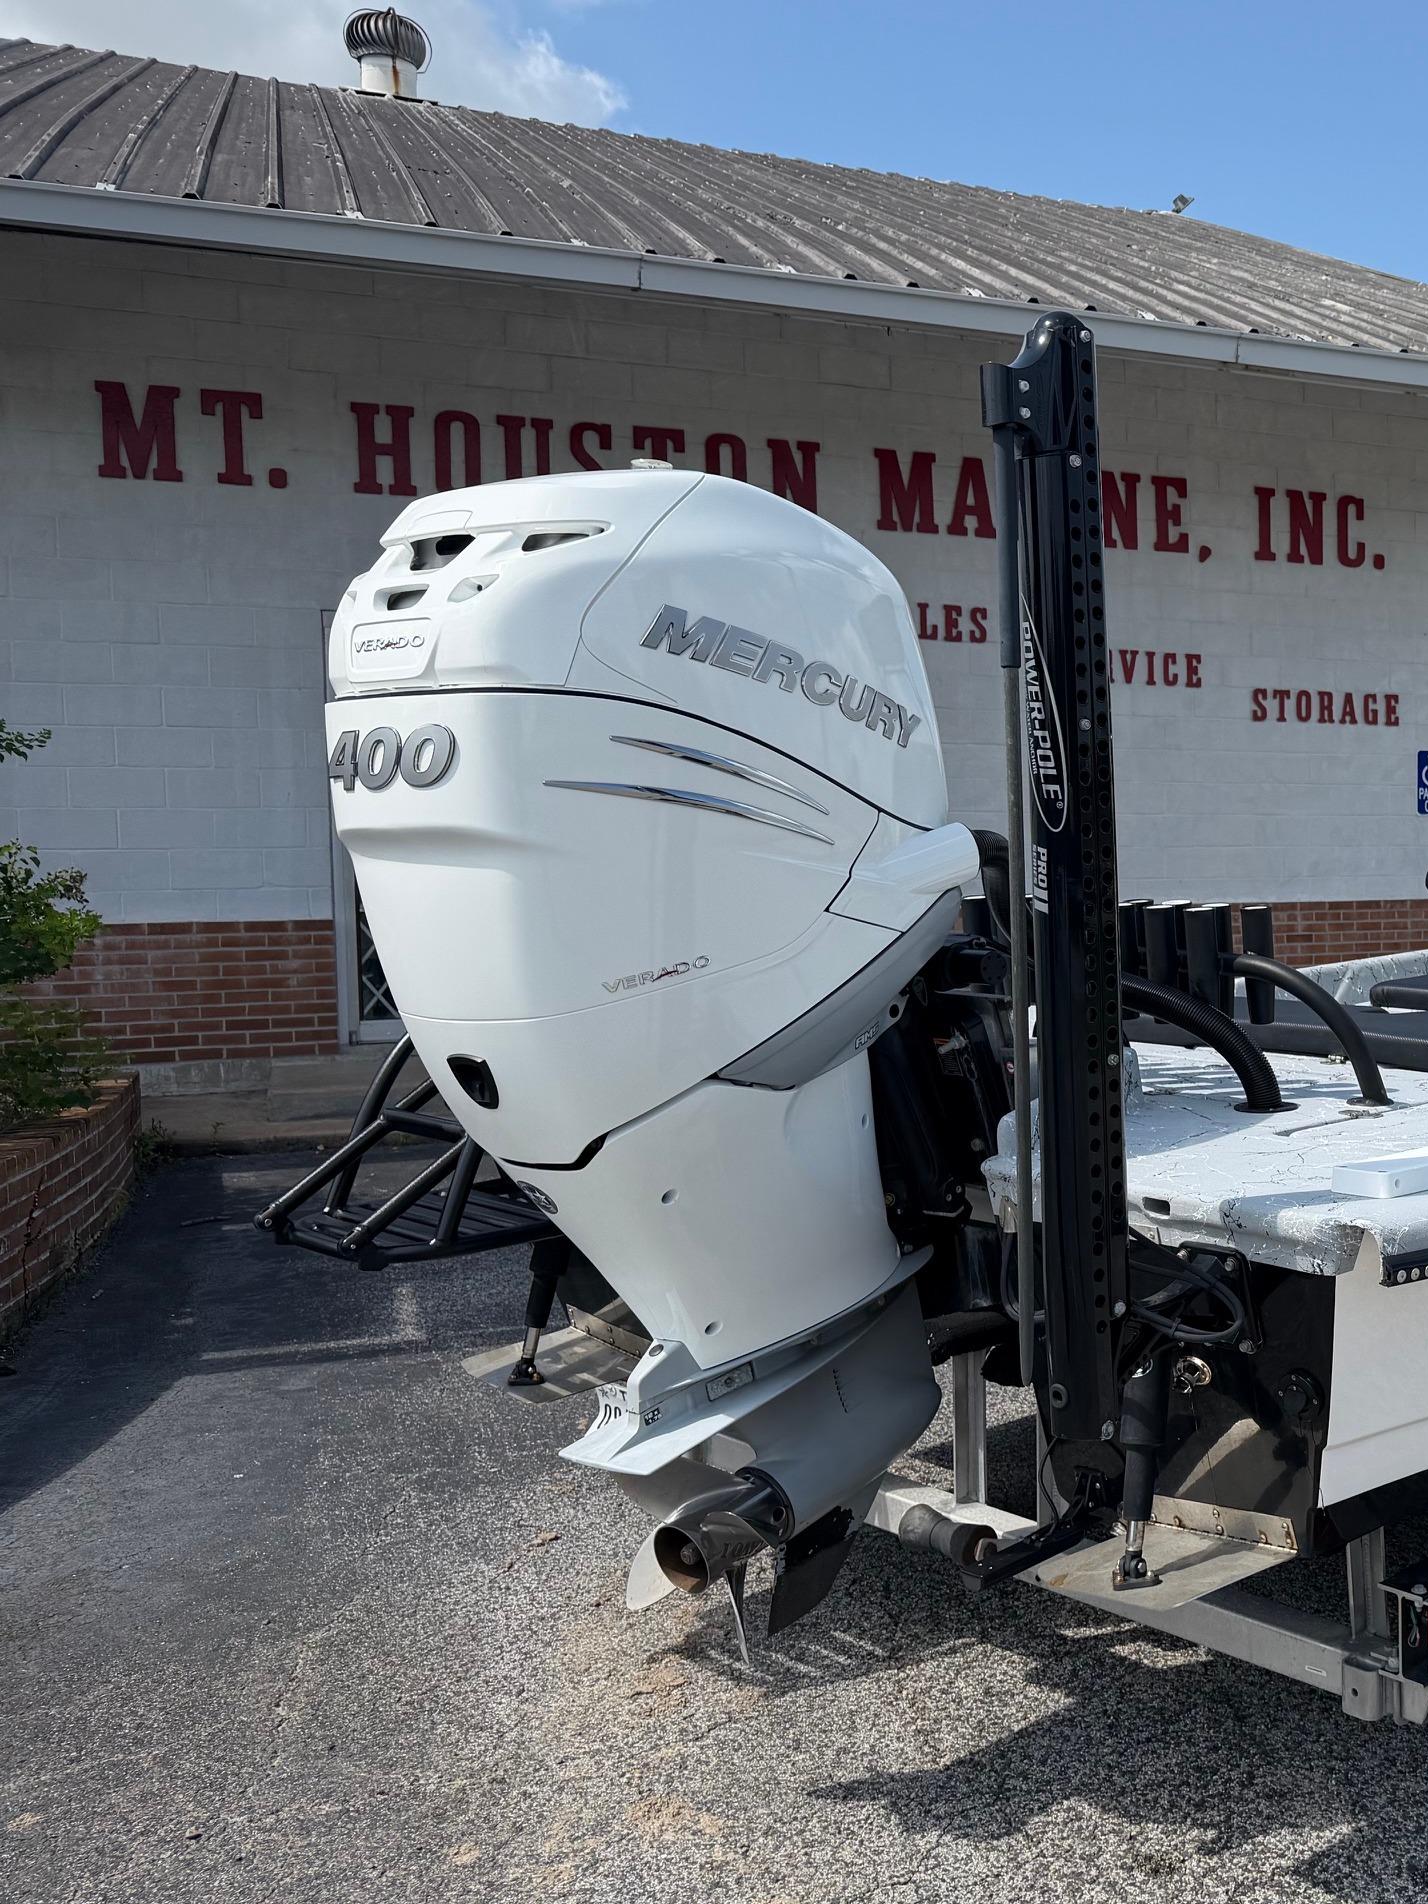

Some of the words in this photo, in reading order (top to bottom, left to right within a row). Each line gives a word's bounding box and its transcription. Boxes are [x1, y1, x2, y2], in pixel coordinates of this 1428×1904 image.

[95, 380, 287, 488] MT.
[350, 402, 820, 514] HOUSTON
[874, 448, 1212, 562] MANE,
[1254, 486, 1385, 570] INC.
[917, 602, 988, 643] LES
[355, 635, 425, 653] VERADO
[639, 603, 922, 748] MERCURY
[1109, 648, 1202, 688] VICE
[1252, 688, 1400, 727] STORAGE
[328, 724, 457, 791] 400
[1037, 846, 1048, 889] PRO
[600, 955, 710, 994] VERADO
